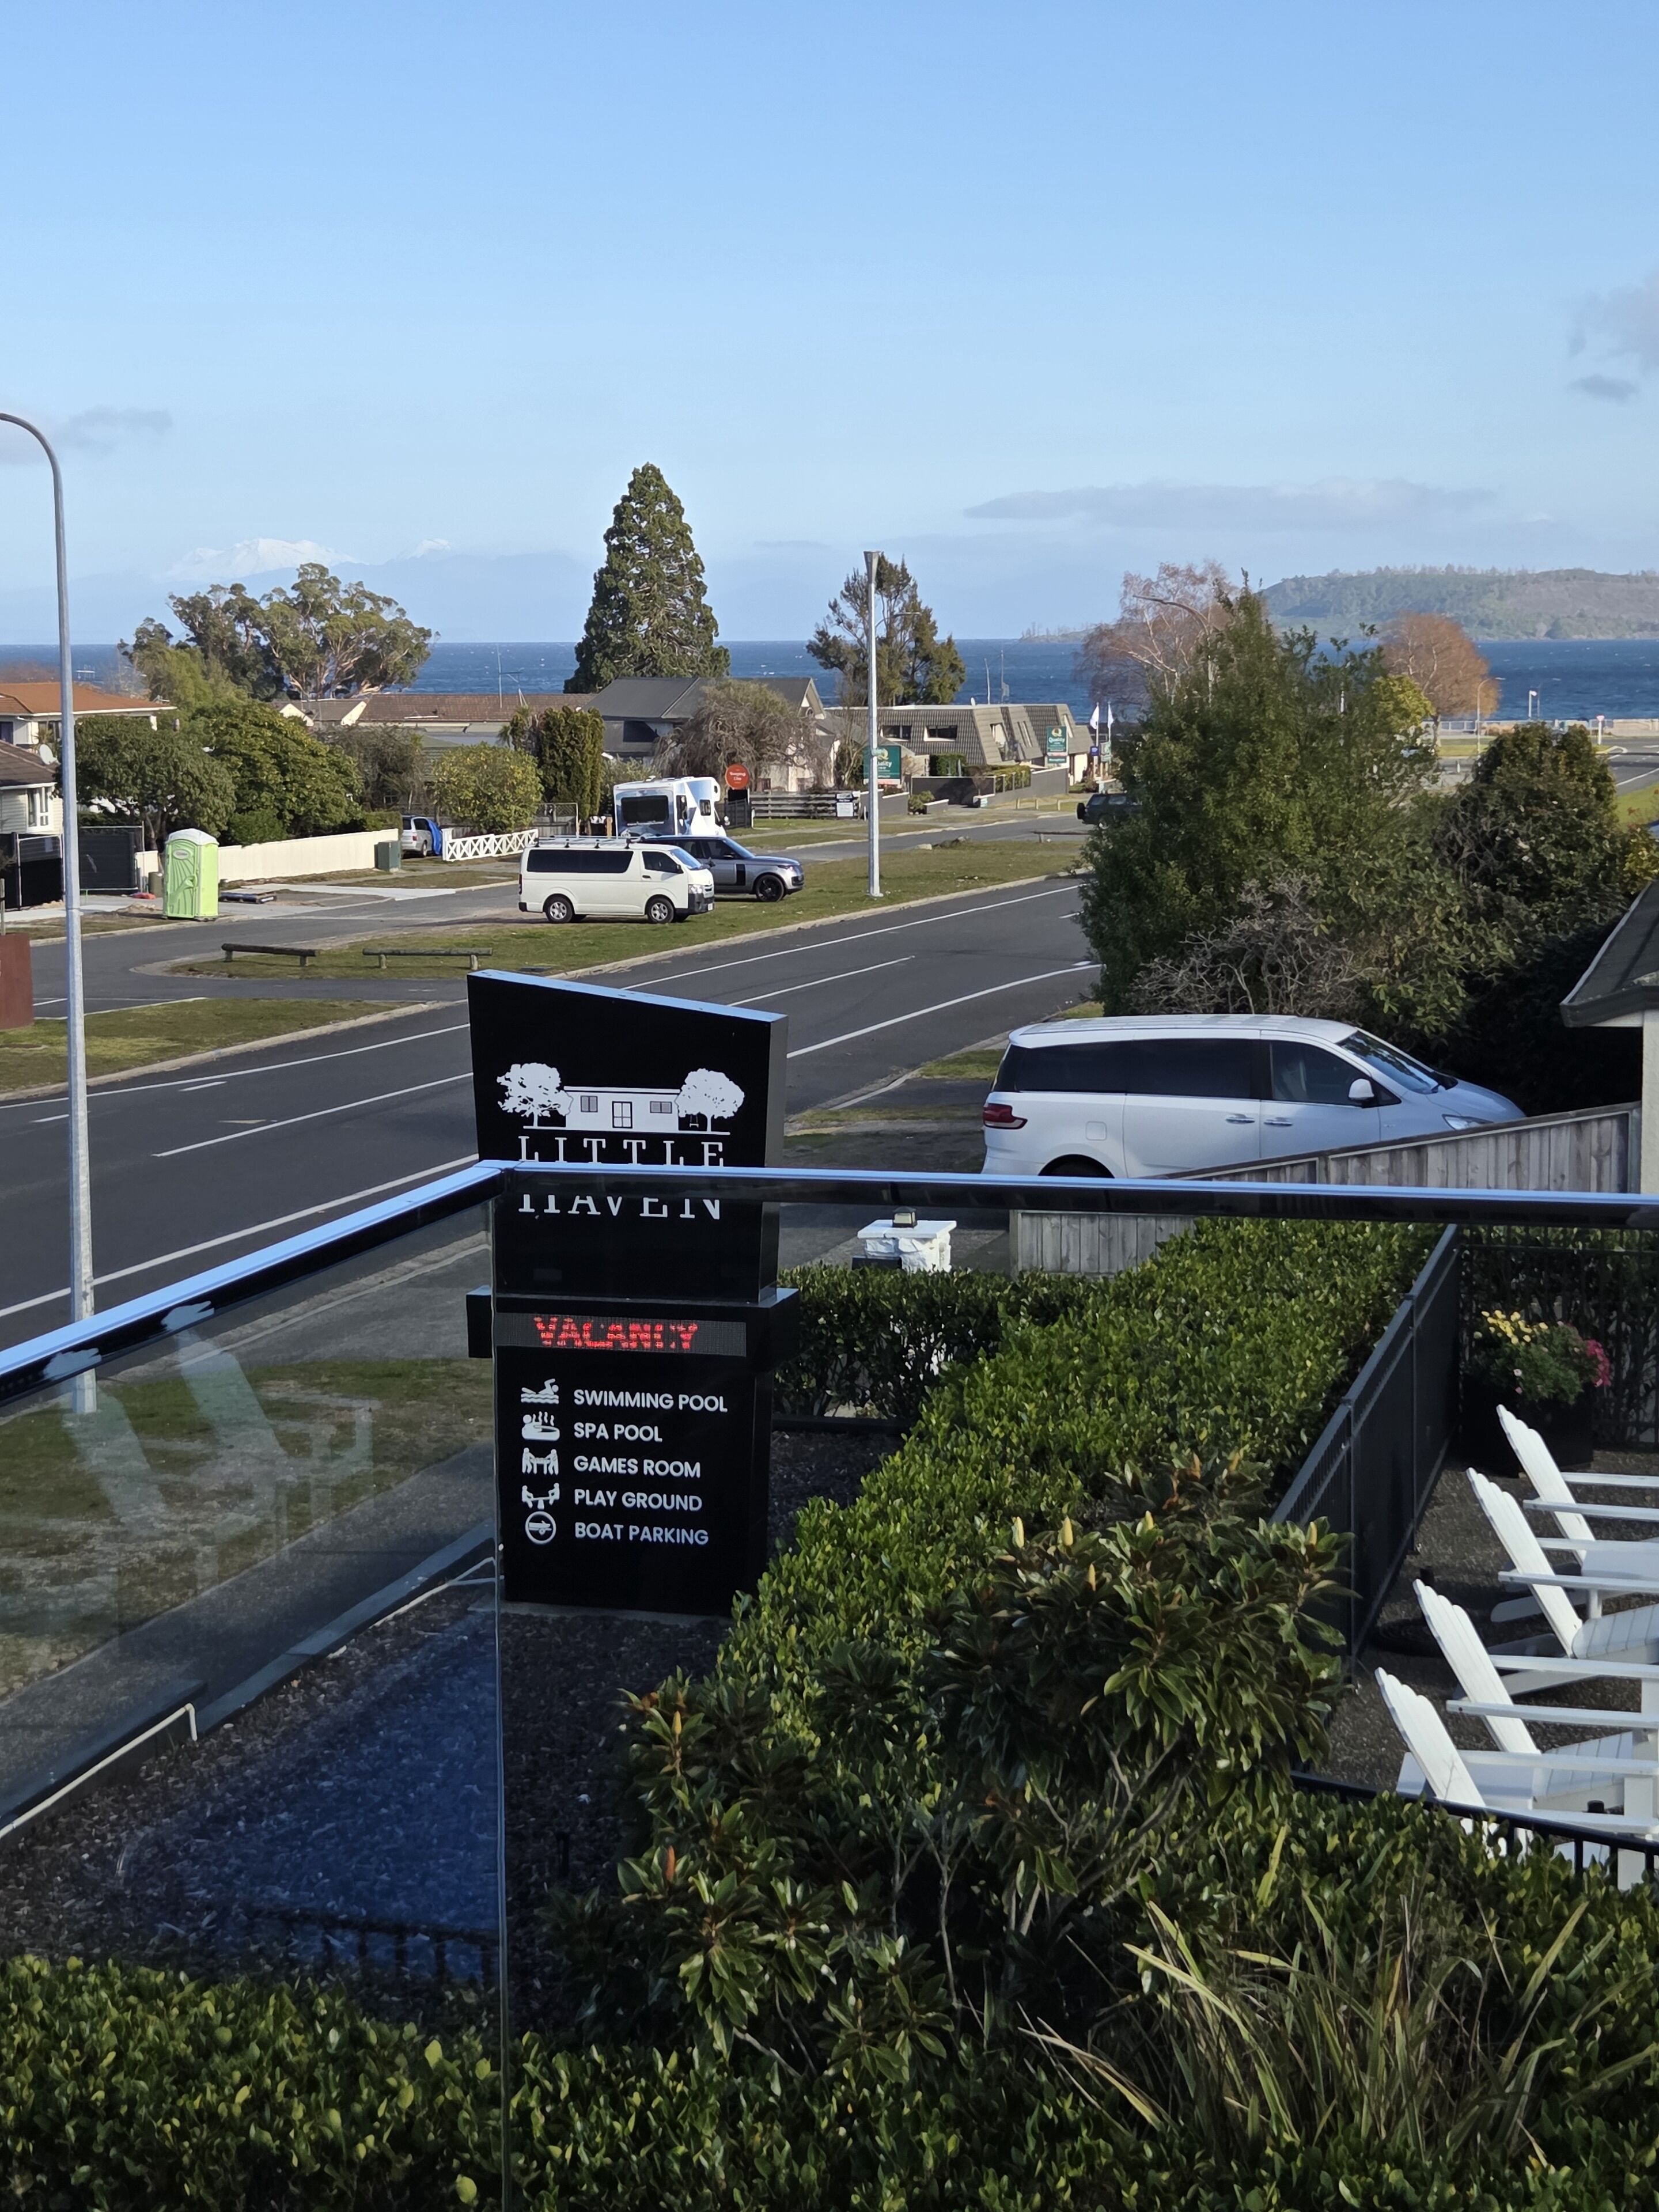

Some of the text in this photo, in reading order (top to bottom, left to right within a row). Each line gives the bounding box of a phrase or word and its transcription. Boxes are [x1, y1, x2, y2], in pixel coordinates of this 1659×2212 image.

[518, 1135, 724, 1166] LITTLE
[574, 1389, 728, 1412] SWIMMING POOL
[574, 1422, 663, 1442] SPA POOL
[573, 1455, 701, 1478] GAMES ROOM
[574, 1488, 702, 1511] PLAY GROUND
[575, 1522, 709, 1545] BOAT PARKING
